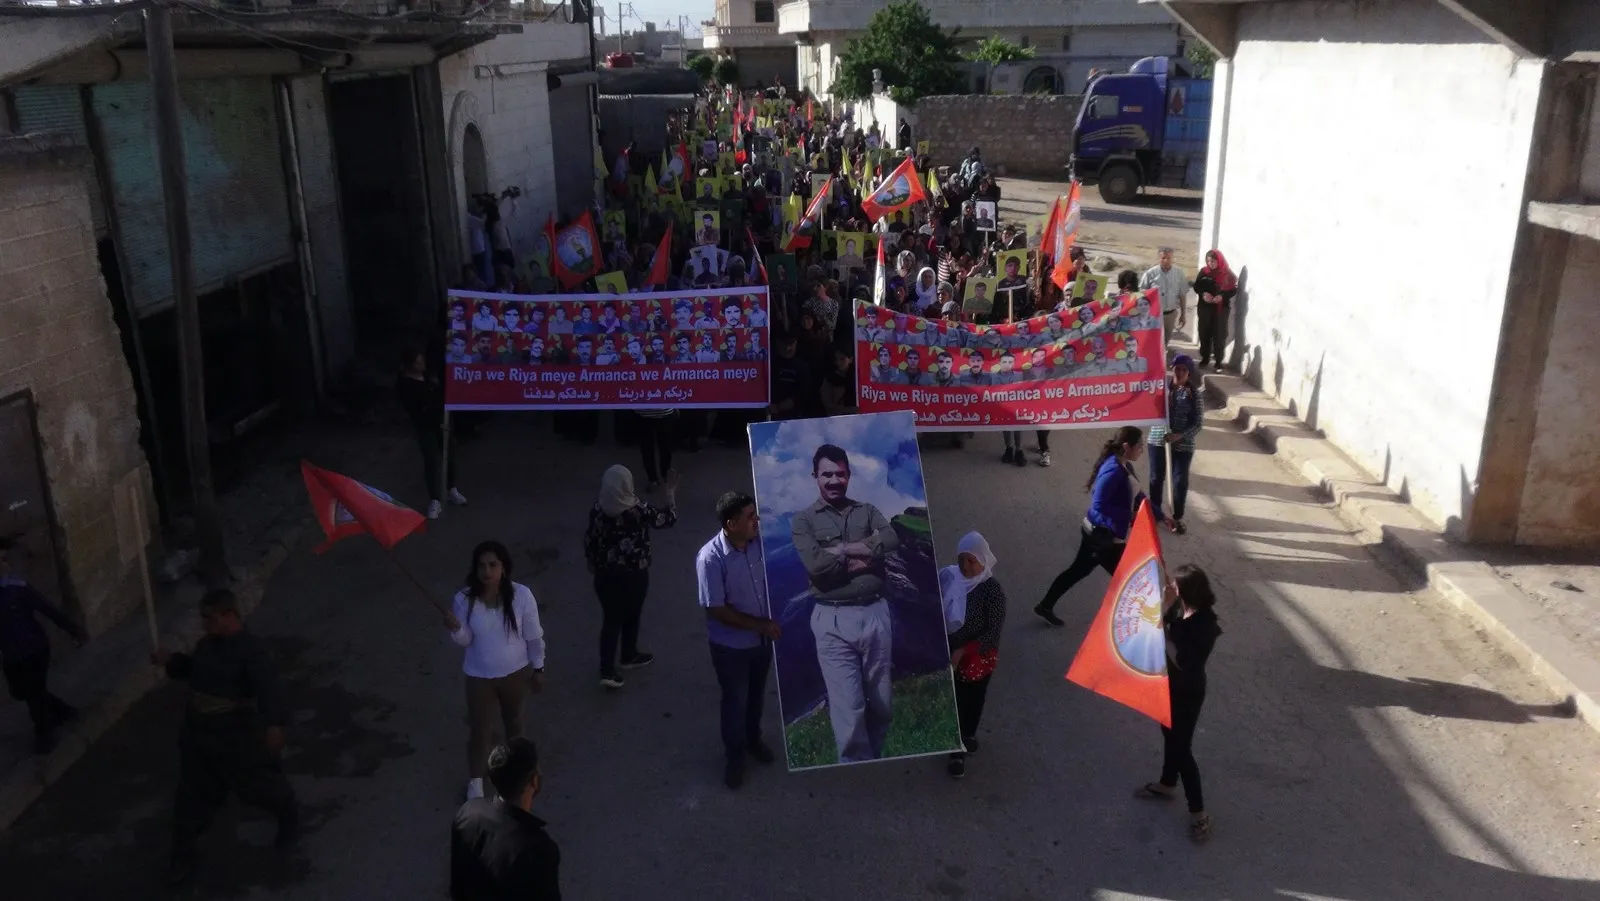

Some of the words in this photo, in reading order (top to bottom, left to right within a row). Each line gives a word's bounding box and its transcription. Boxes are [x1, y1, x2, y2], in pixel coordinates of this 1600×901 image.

[454, 367, 482, 384] Riya
[486, 369, 505, 381] we
[509, 368, 537, 384] Riya
[541, 371, 575, 385] meye
[580, 368, 636, 382] Armanca
[640, 370, 659, 381] we
[663, 367, 720, 381] Armanca
[723, 367, 758, 382] meye
[523, 386, 556, 399] هدفنا
[558, 387, 592, 402] هدفكم
[861, 385, 886, 403] Riya
[889, 390, 908, 402] we
[912, 389, 939, 406] Riya
[943, 393, 979, 407] meye
[982, 389, 1041, 403] Armanca
[1044, 387, 1064, 399] we
[1068, 381, 1126, 397] Armanca
[1129, 378, 1164, 394] meye
[940, 409, 980, 425] هدفكم
